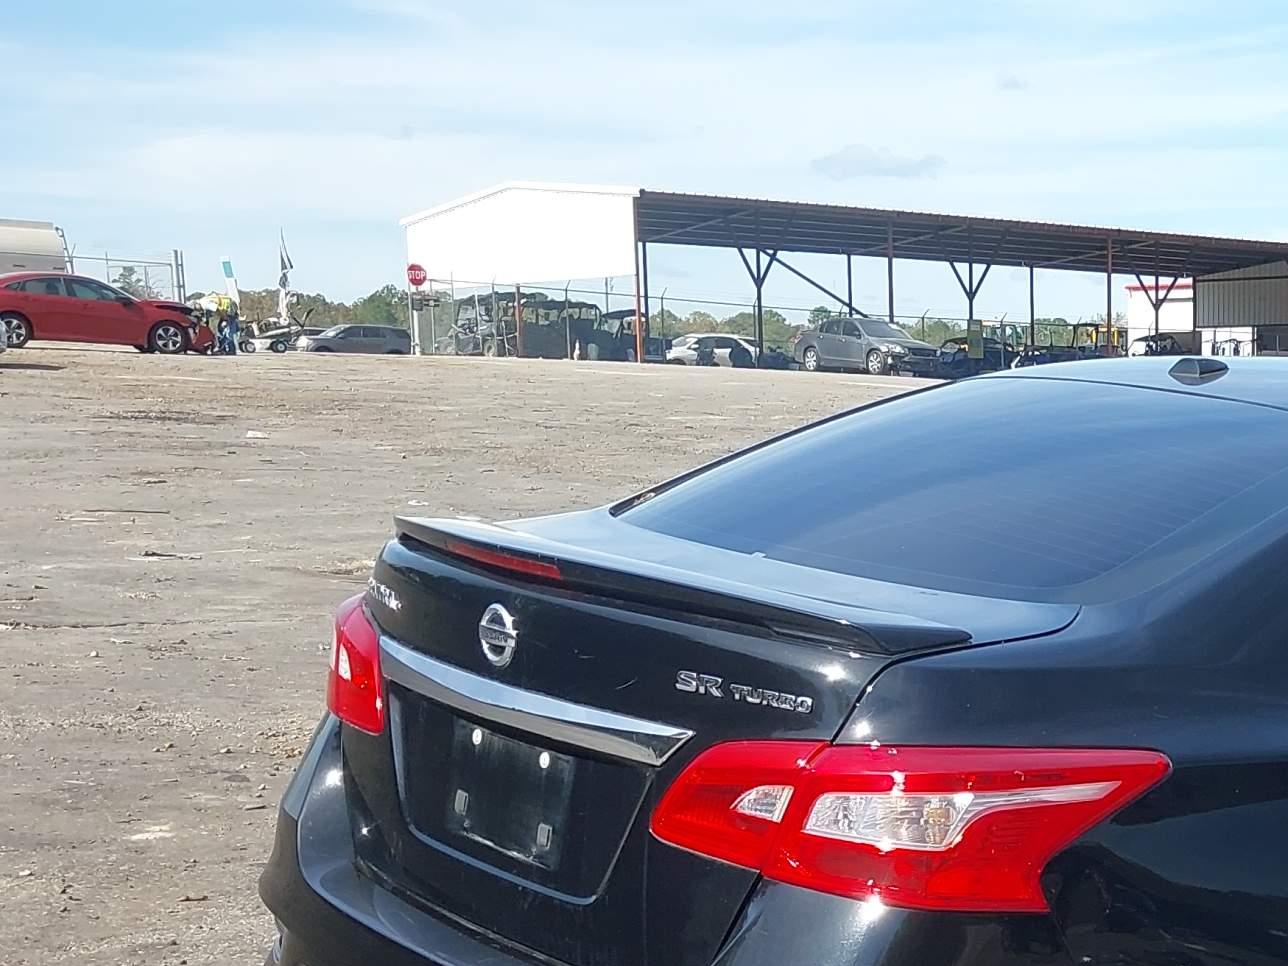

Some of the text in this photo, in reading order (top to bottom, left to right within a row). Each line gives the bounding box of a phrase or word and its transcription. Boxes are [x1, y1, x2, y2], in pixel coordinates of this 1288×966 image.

[408, 270, 426, 280] STOP
[675, 670, 814, 714] SR TURBO
